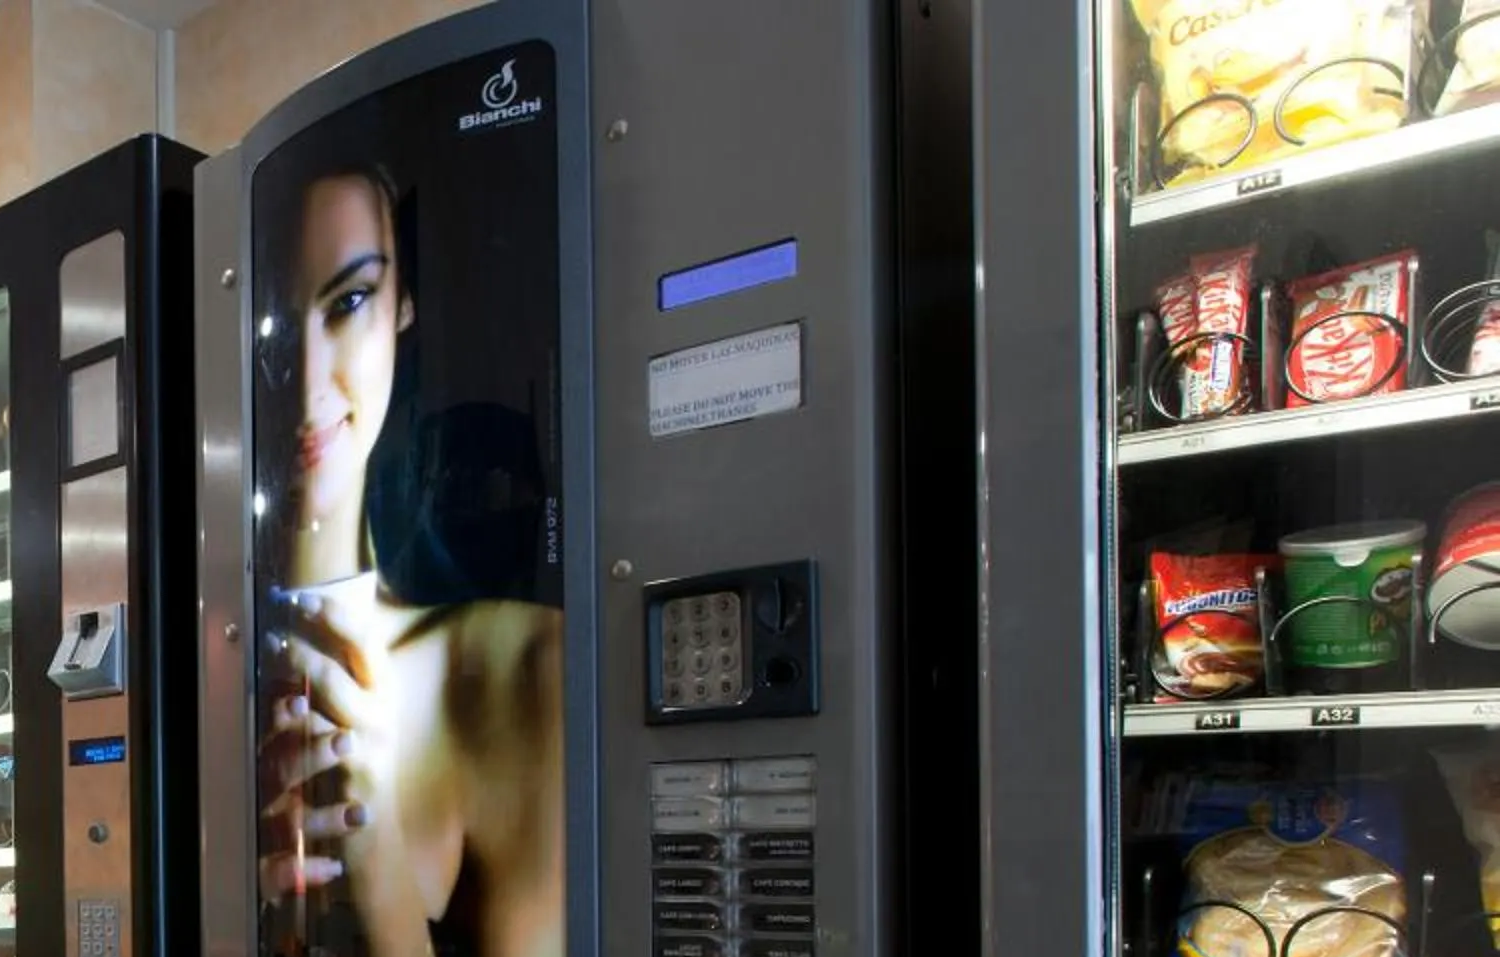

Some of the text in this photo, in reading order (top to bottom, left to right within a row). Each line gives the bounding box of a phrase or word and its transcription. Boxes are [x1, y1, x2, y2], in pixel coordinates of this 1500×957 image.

[459, 97, 542, 130] Bianchi
[1302, 318, 1373, 387] KitKat
[739, 384, 773, 401] MOVE
[1202, 712, 1233, 727] A31
[1317, 706, 1354, 722] A32
